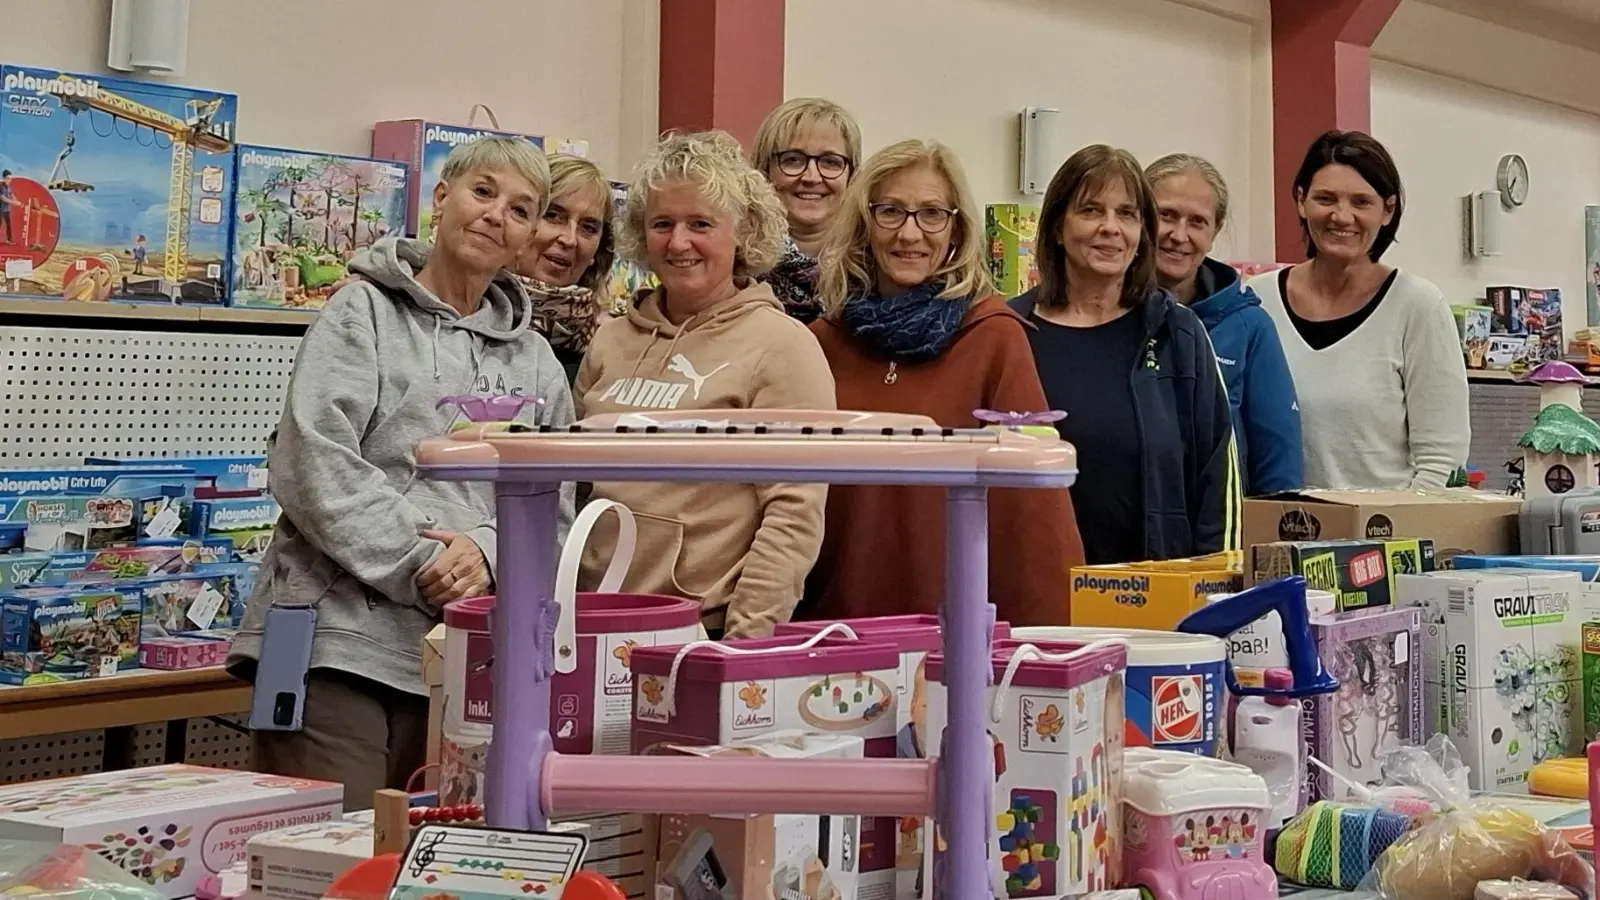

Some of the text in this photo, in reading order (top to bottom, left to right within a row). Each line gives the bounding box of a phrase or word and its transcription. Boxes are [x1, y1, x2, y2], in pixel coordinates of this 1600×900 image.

[4, 70, 100, 97] playmobil
[8, 94, 48, 108] CITY
[11, 105, 52, 117] ACTION
[426, 126, 492, 147] playmob
[241, 151, 308, 172] playmobil
[600, 377, 689, 409] PUMA
[71, 478, 89, 488] City
[214, 505, 271, 524] playmobil
[1282, 523, 1316, 535] vtech
[1368, 524, 1391, 537] vtech
[1305, 556, 1335, 592] GECKO
[1353, 553, 1383, 585] BIG BOX
[1073, 573, 1151, 593] playmobil
[34, 601, 87, 620] playmobil
[608, 673, 632, 685] Eich
[468, 700, 492, 718] Inkl.
[1160, 699, 1190, 726] HER
[734, 711, 773, 726] Eichhorn
[1022, 698, 1034, 748] Eichhorn
[275, 819, 285, 828] et
[287, 813, 315, 826] fruits
[316, 811, 332, 822] Set
[219, 838, 247, 851] e-Set
